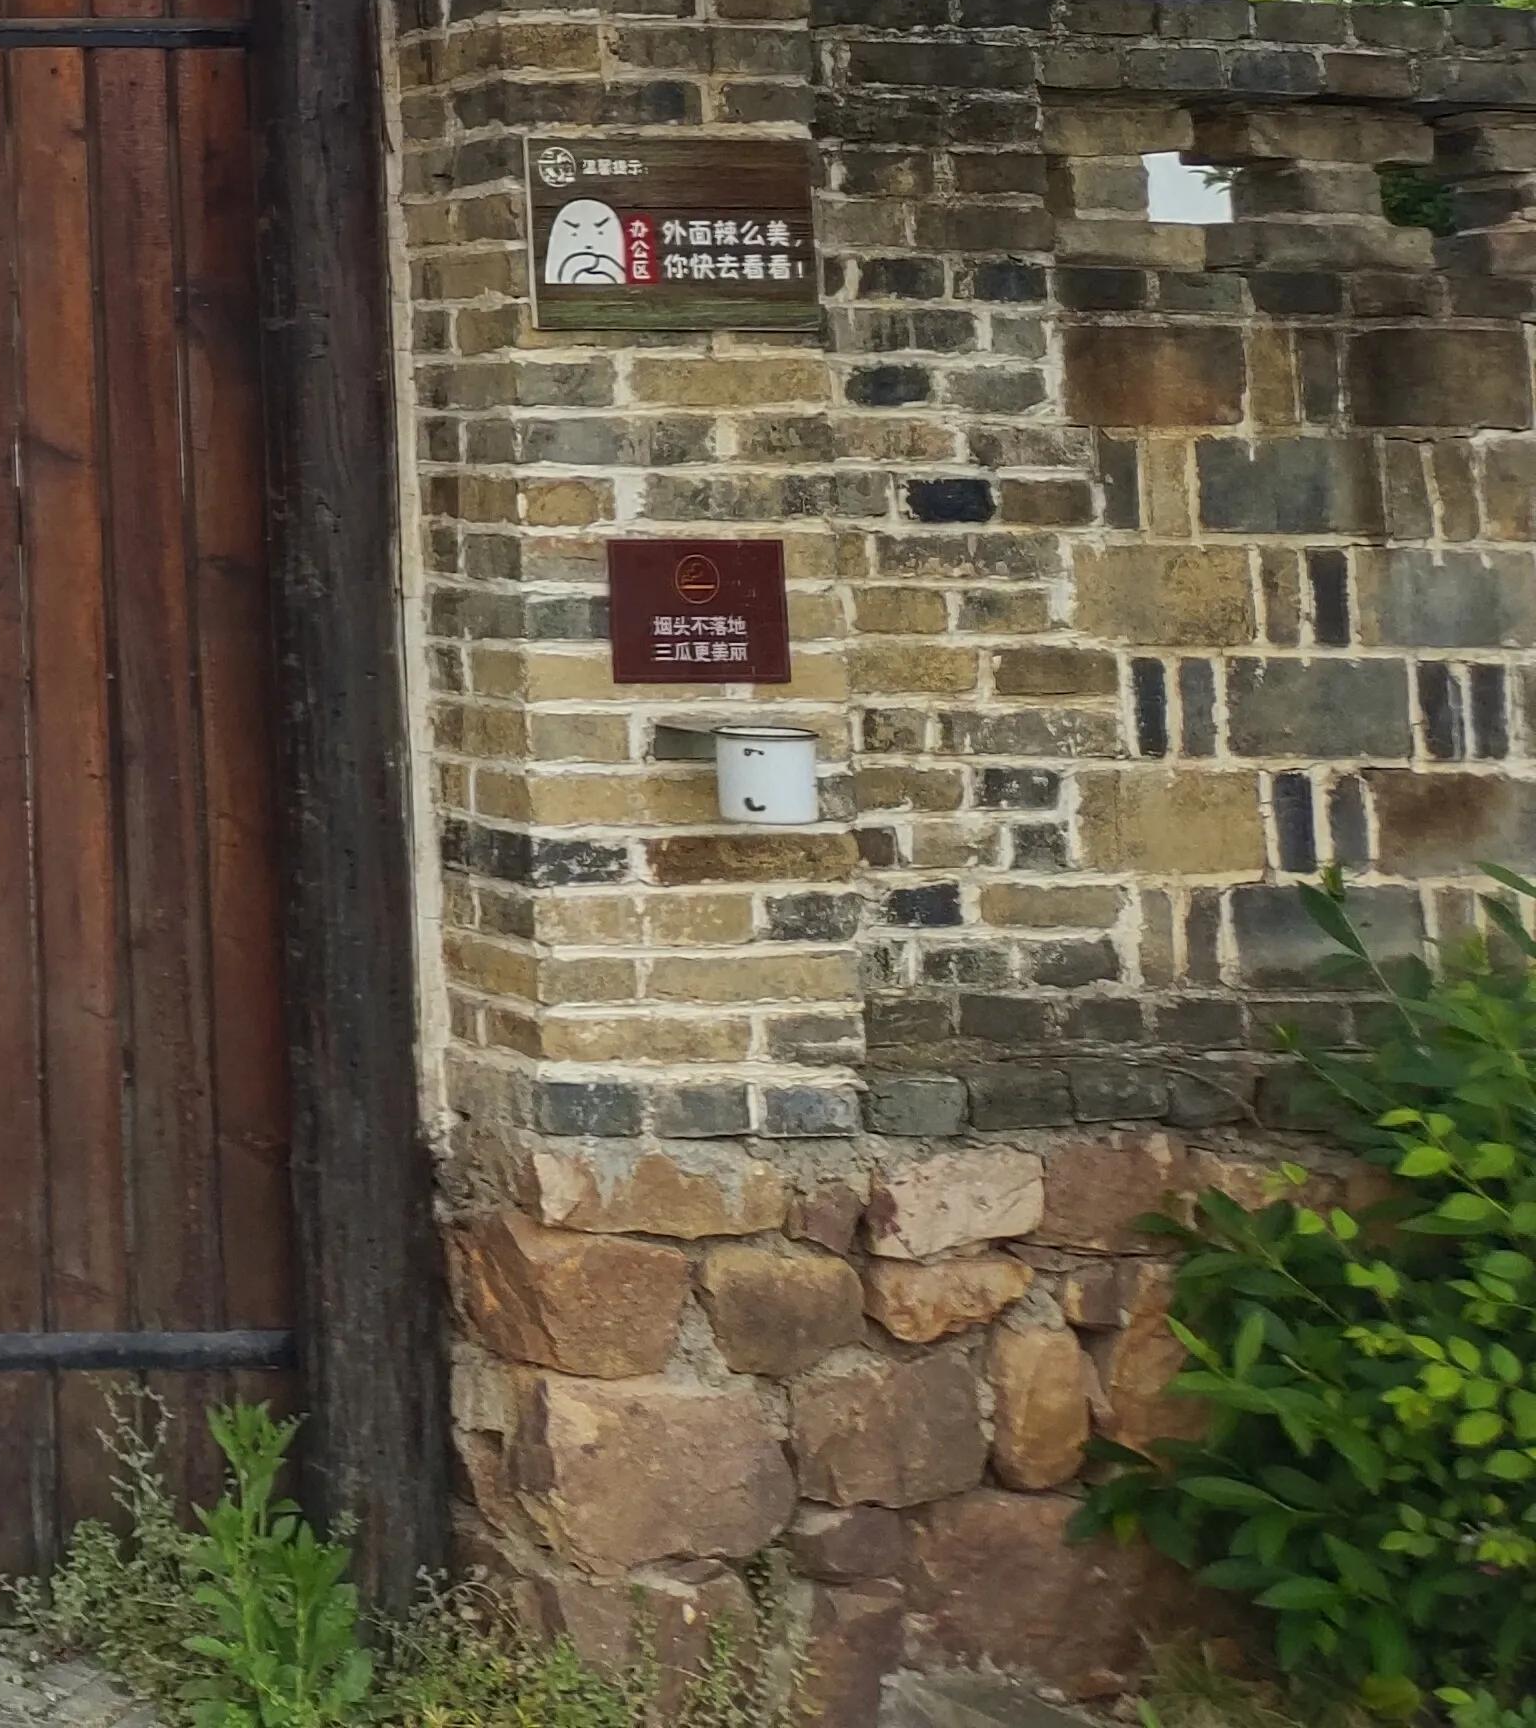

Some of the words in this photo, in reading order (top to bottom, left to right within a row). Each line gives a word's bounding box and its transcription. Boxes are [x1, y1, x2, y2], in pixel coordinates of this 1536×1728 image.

[653, 615, 747, 636] 烟头不落地
[653, 641, 747, 662] 三瓜更美丽
